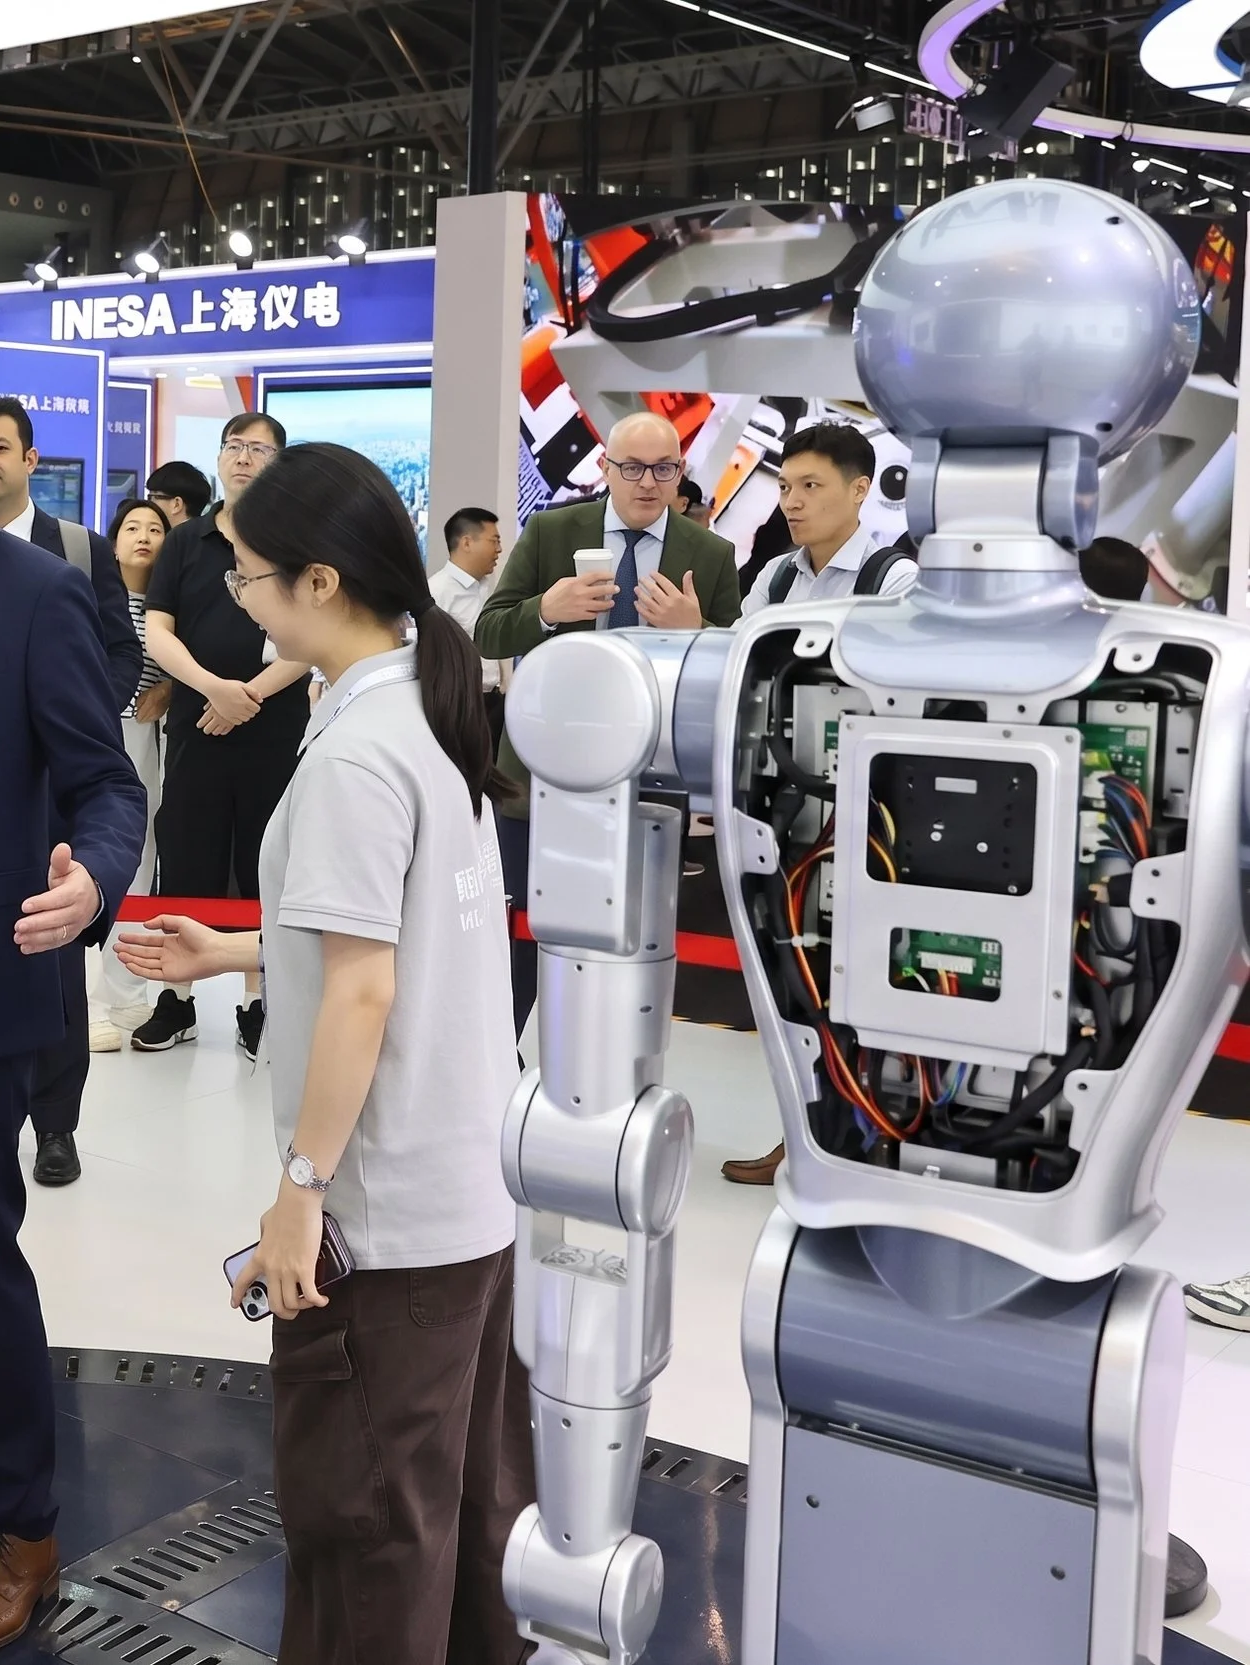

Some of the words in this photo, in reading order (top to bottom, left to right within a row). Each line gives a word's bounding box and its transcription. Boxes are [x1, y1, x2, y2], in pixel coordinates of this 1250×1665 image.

[51, 292, 177, 341] INESA
[180, 281, 341, 333] 上海仪电
